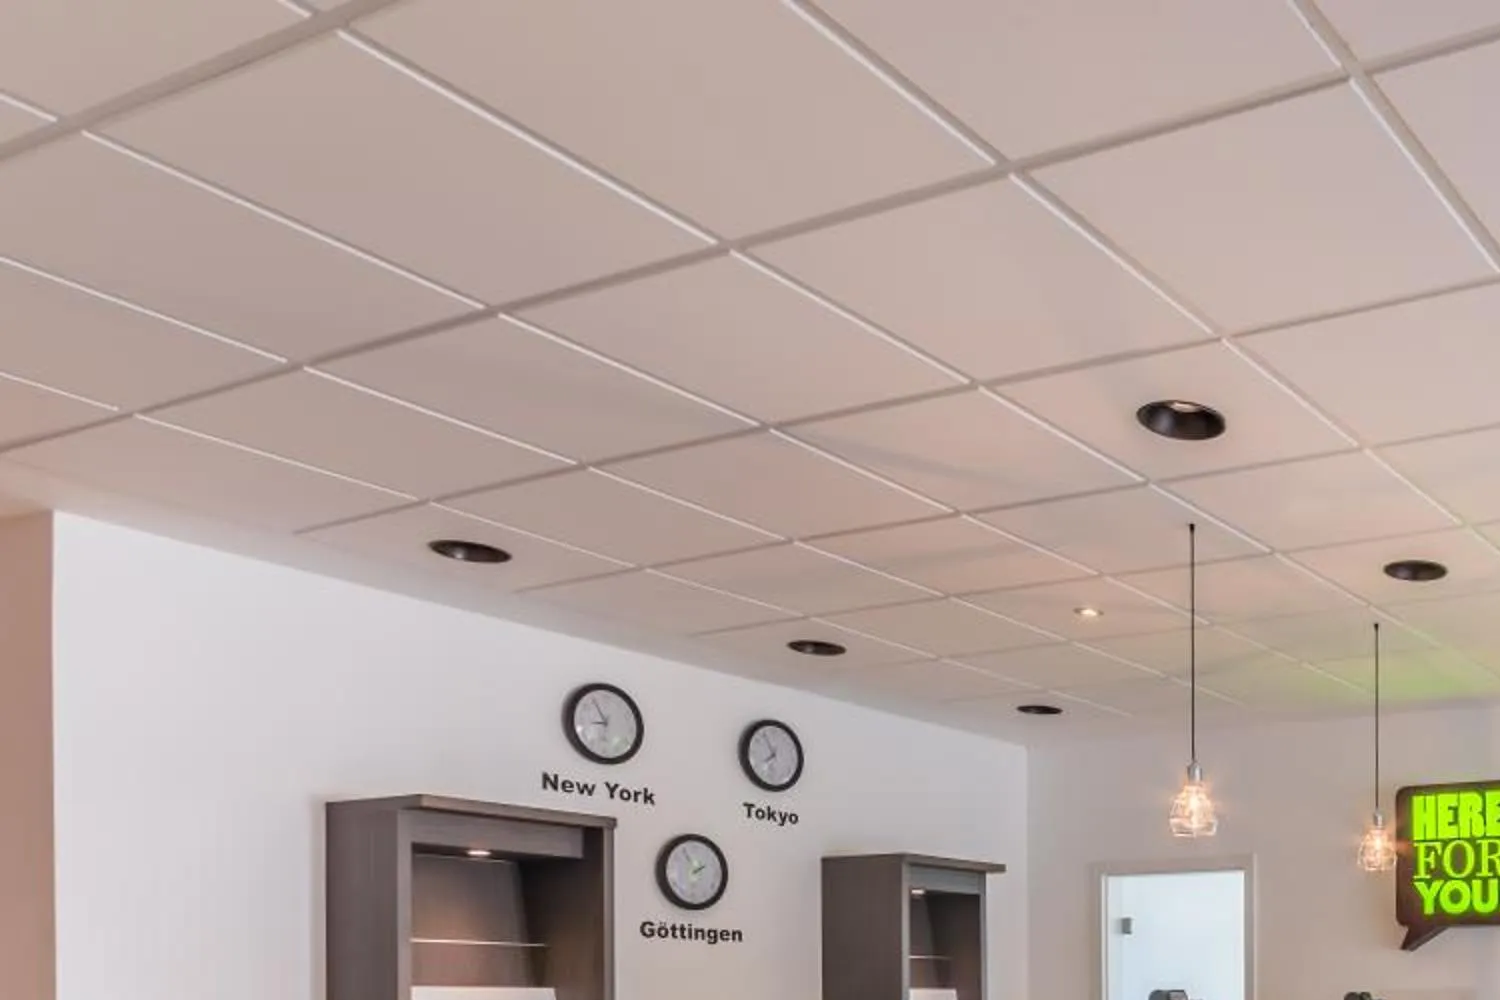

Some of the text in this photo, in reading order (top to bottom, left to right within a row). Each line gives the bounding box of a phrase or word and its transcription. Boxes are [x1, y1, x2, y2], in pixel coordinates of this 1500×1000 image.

[541, 772, 656, 806] New York
[742, 802, 799, 827] Tokyo
[639, 920, 743, 945] Göttingen
